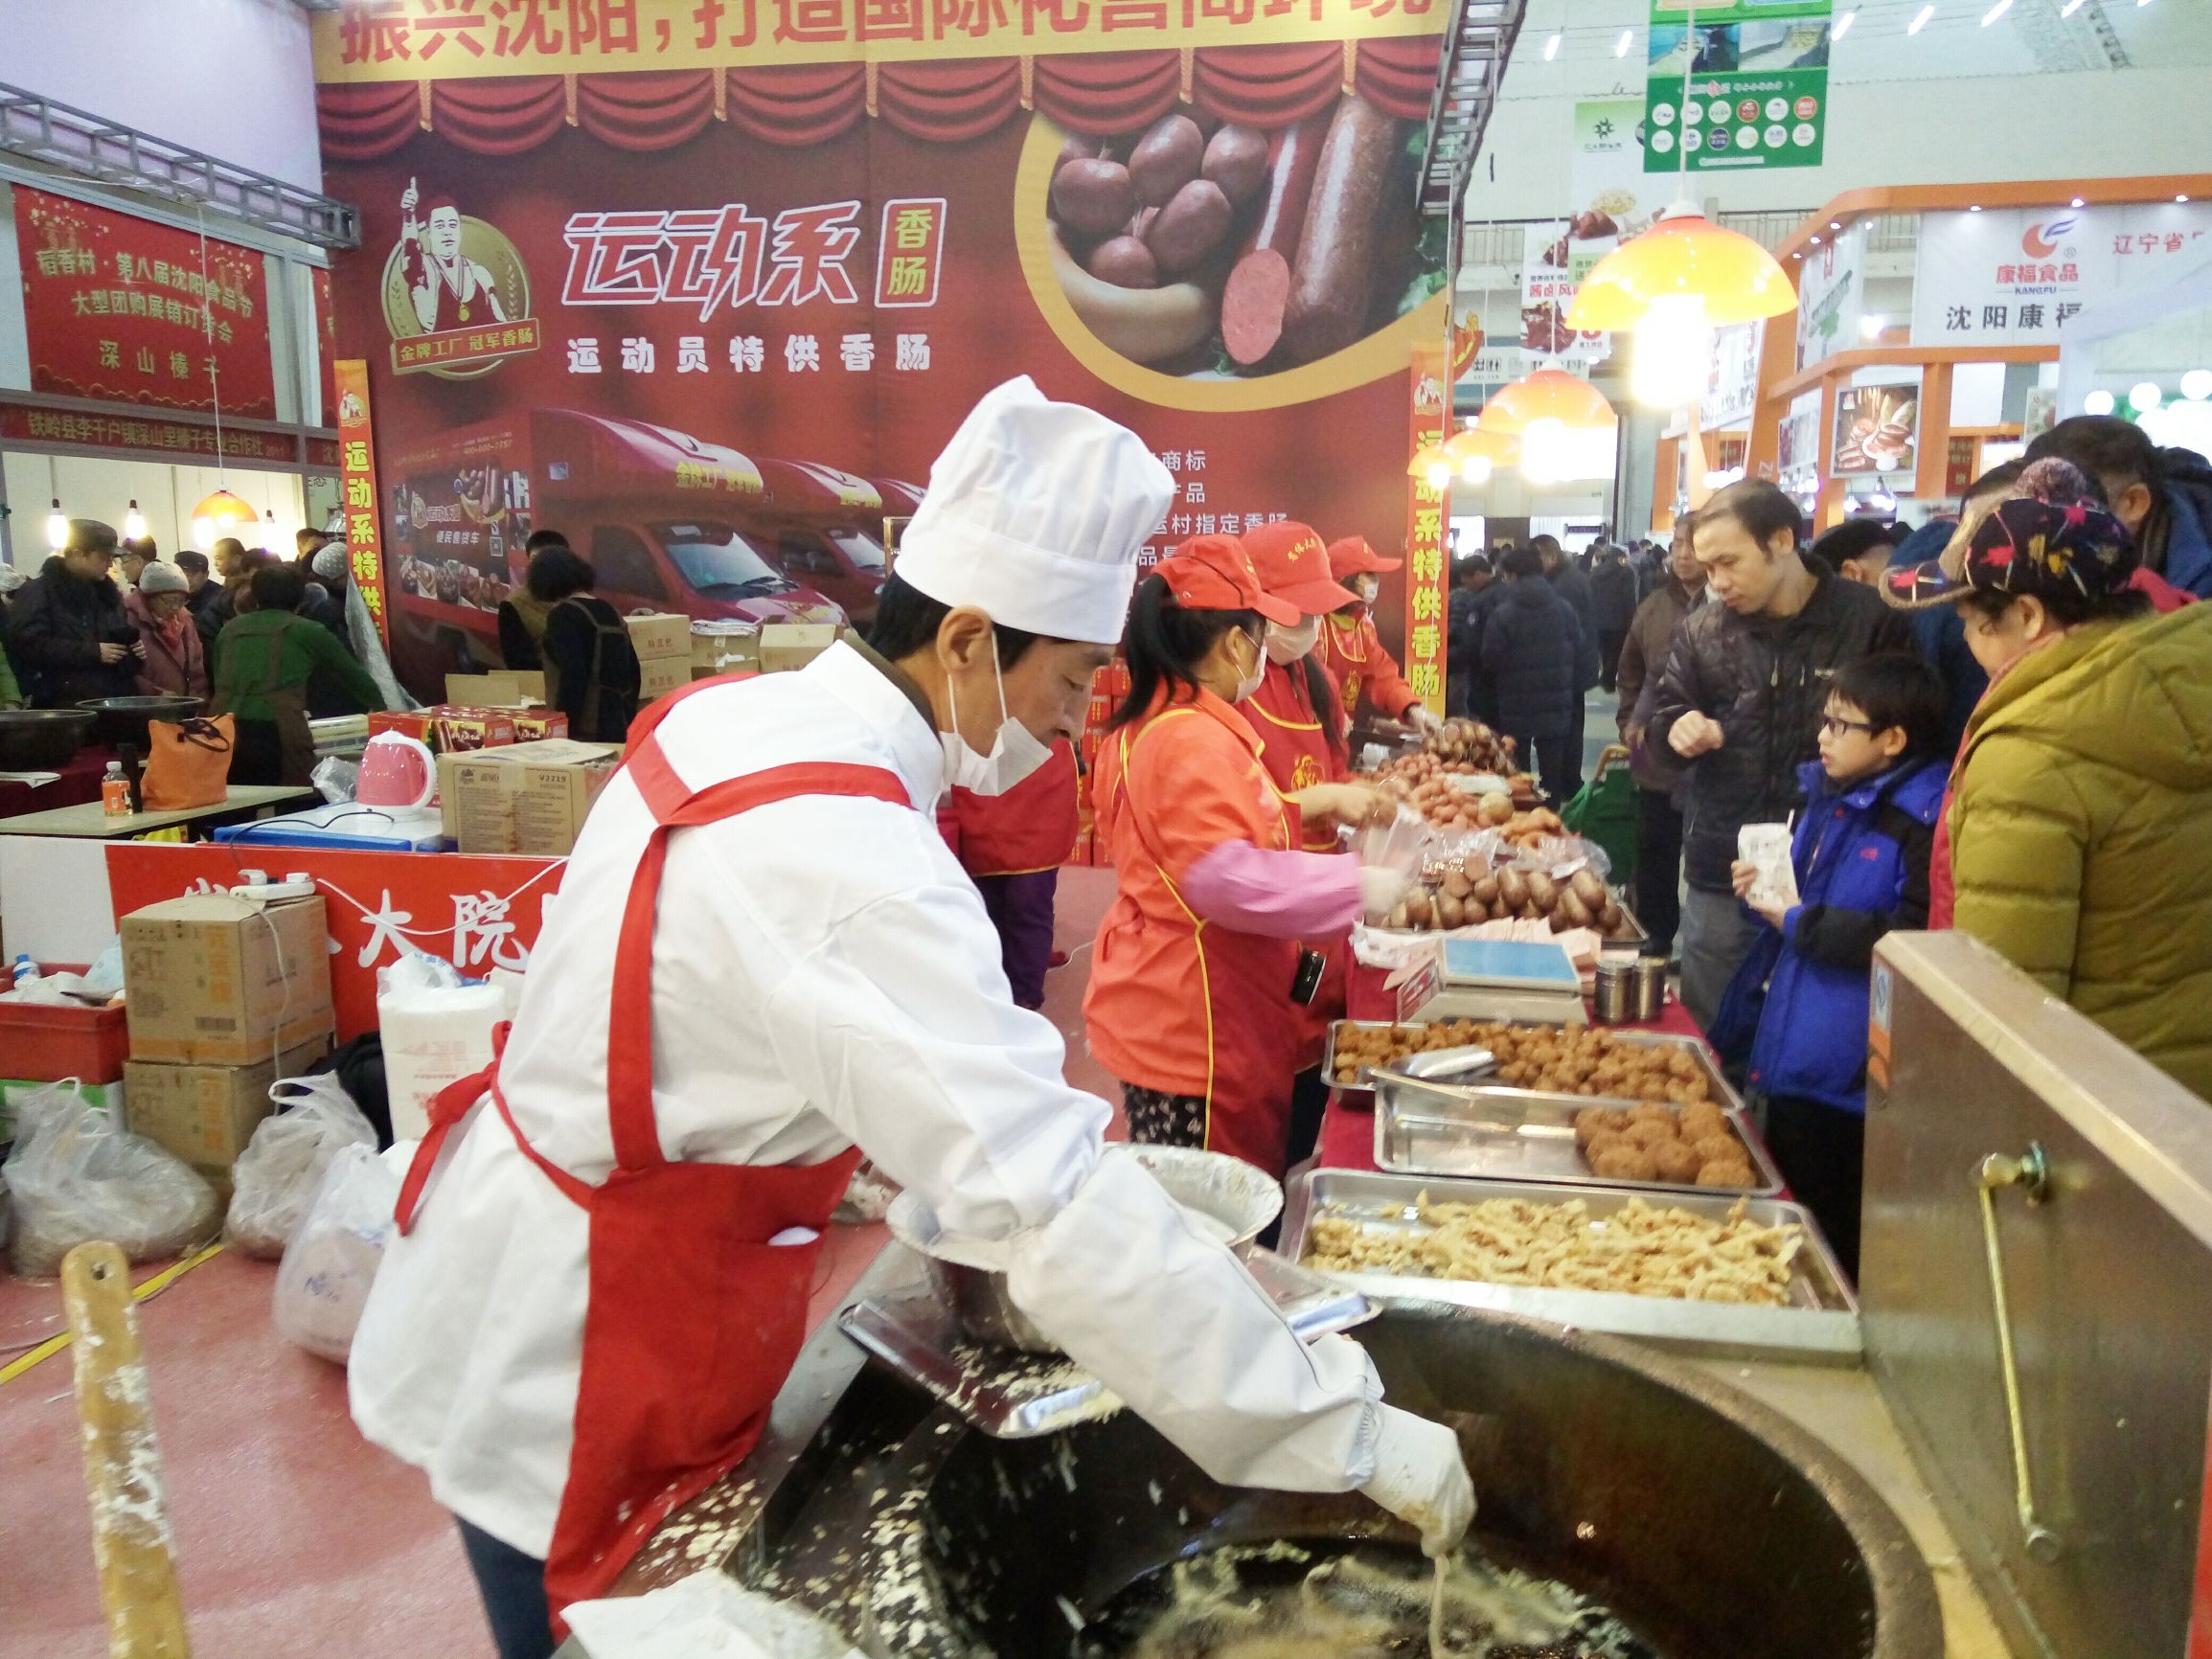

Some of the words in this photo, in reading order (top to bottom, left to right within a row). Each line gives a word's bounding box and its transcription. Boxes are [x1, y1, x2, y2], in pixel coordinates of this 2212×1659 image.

[339, 0, 1437, 64] 振兴沈阳，打造国际化
[561, 200, 861, 322] 运动系
[886, 208, 931, 297] 香肠
[1995, 263, 2079, 284] 康福食品
[399, 337, 463, 362] 金牌工厂
[468, 328, 534, 352] 冠军香肠
[566, 333, 931, 375] 运动员特供香肠
[1152, 449, 1206, 471] 商标
[345, 441, 382, 636] 运动系特供
